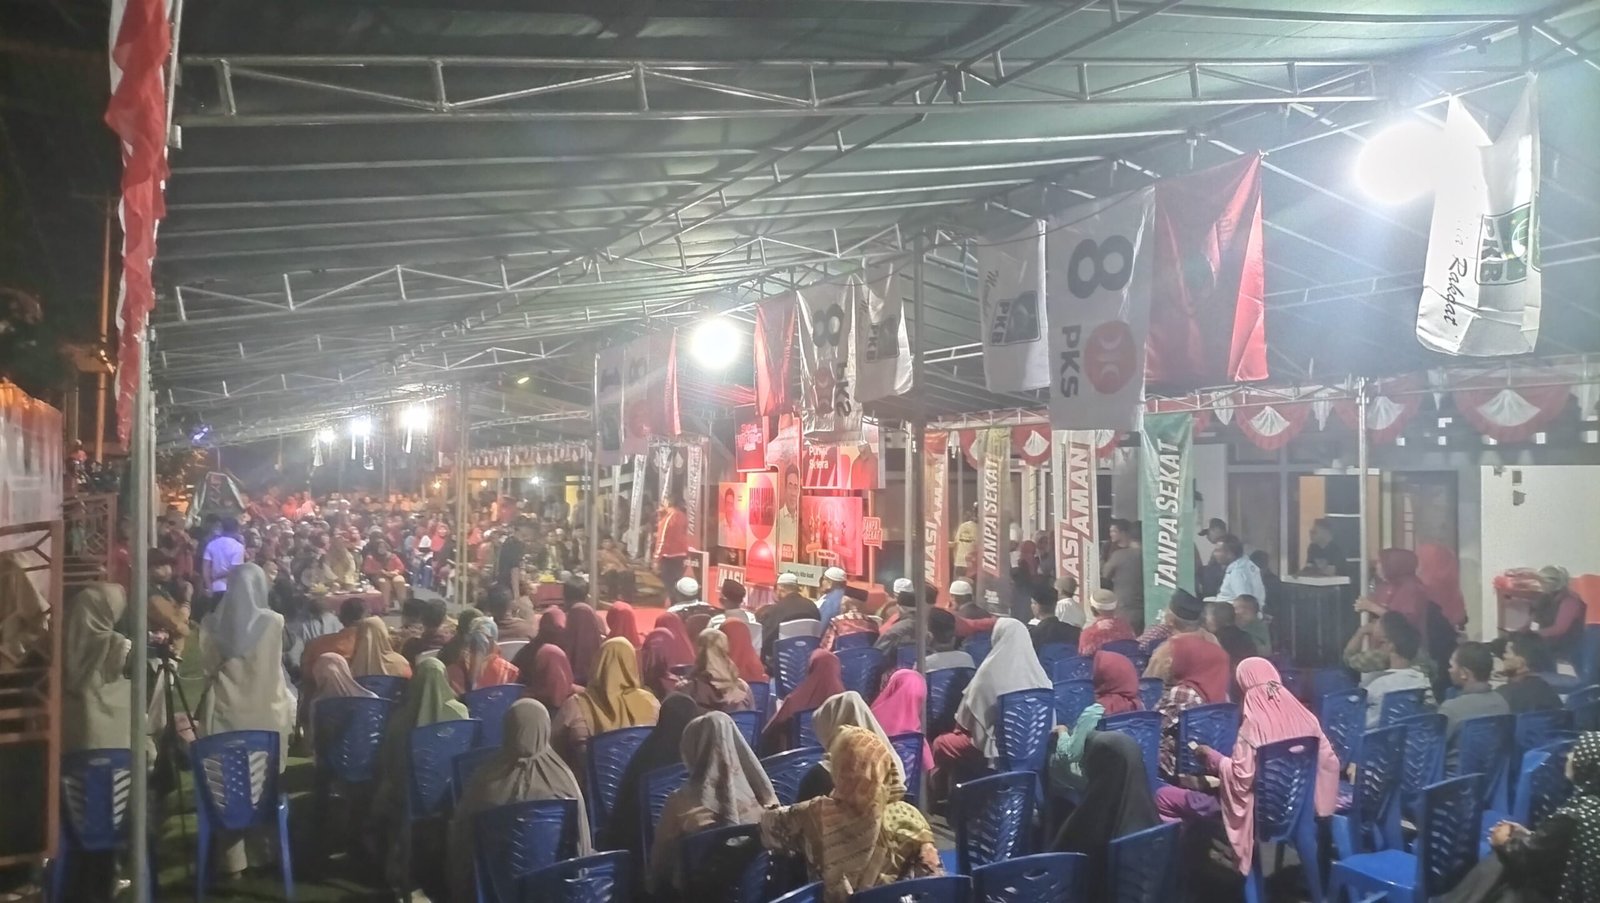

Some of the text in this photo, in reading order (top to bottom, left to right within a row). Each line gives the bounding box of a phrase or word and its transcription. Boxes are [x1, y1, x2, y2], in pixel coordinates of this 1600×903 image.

[1067, 235, 1134, 299] 8
[1480, 217, 1503, 283] PKB
[812, 303, 845, 348] 8
[991, 301, 1010, 344] PKB
[1060, 324, 1081, 398] PKS
[984, 456, 1000, 515] SEKAT
[1070, 447, 1090, 536] AMAN
[1155, 438, 1180, 514] SEKAT
[925, 521, 938, 583] MASI
[982, 516, 998, 571] TANPA
[1062, 528, 1080, 602] ASI
[1154, 517, 1178, 590] TANPA
